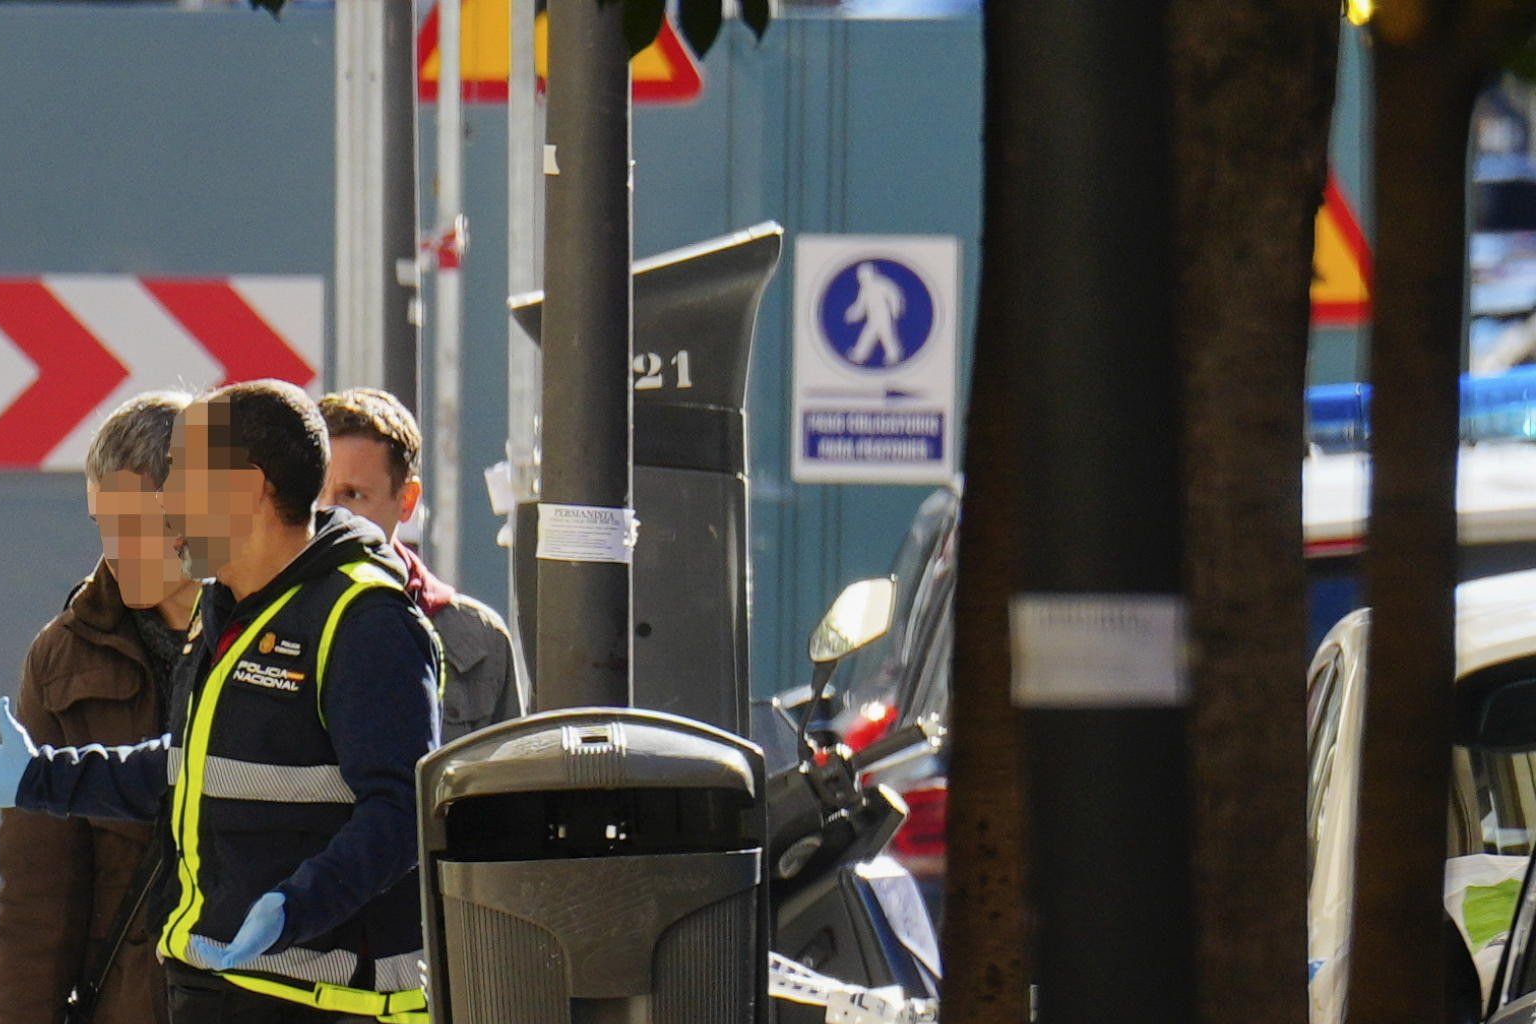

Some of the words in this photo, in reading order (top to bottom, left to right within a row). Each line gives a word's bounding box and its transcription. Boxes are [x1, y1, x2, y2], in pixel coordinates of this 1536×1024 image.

[632, 350, 693, 390] 21
[237, 660, 288, 679] POLICIA
[233, 670, 299, 692] NACIONAL
